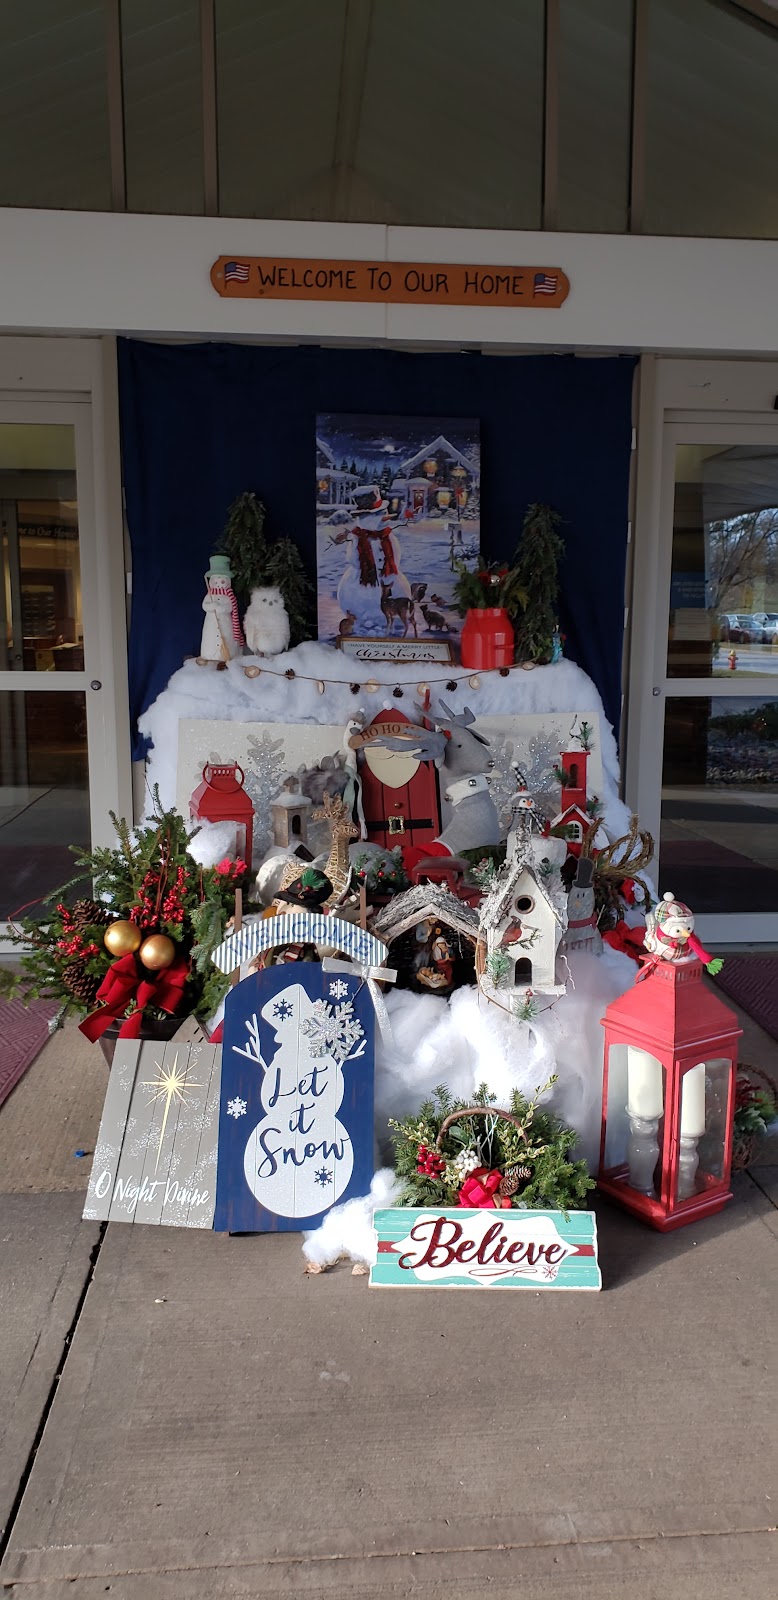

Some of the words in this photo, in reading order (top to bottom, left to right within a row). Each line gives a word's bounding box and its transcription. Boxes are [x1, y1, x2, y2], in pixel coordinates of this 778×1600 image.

[257, 265, 357, 290] WELCOME
[368, 267, 391, 291] TO
[404, 270, 449, 294] OUR
[464, 271, 524, 295] HOME
[361, 727, 379, 741] HO
[381, 724, 401, 734] HO
[226, 920, 374, 957] WELCOME
[268, 1066, 328, 1107] Let
[289, 1102, 316, 1134] it
[257, 1127, 350, 1178] Snow
[95, 1170, 112, 1198] O
[112, 1175, 167, 1214] Night
[163, 1177, 211, 1207] Divine
[398, 1216, 567, 1270] Believe
